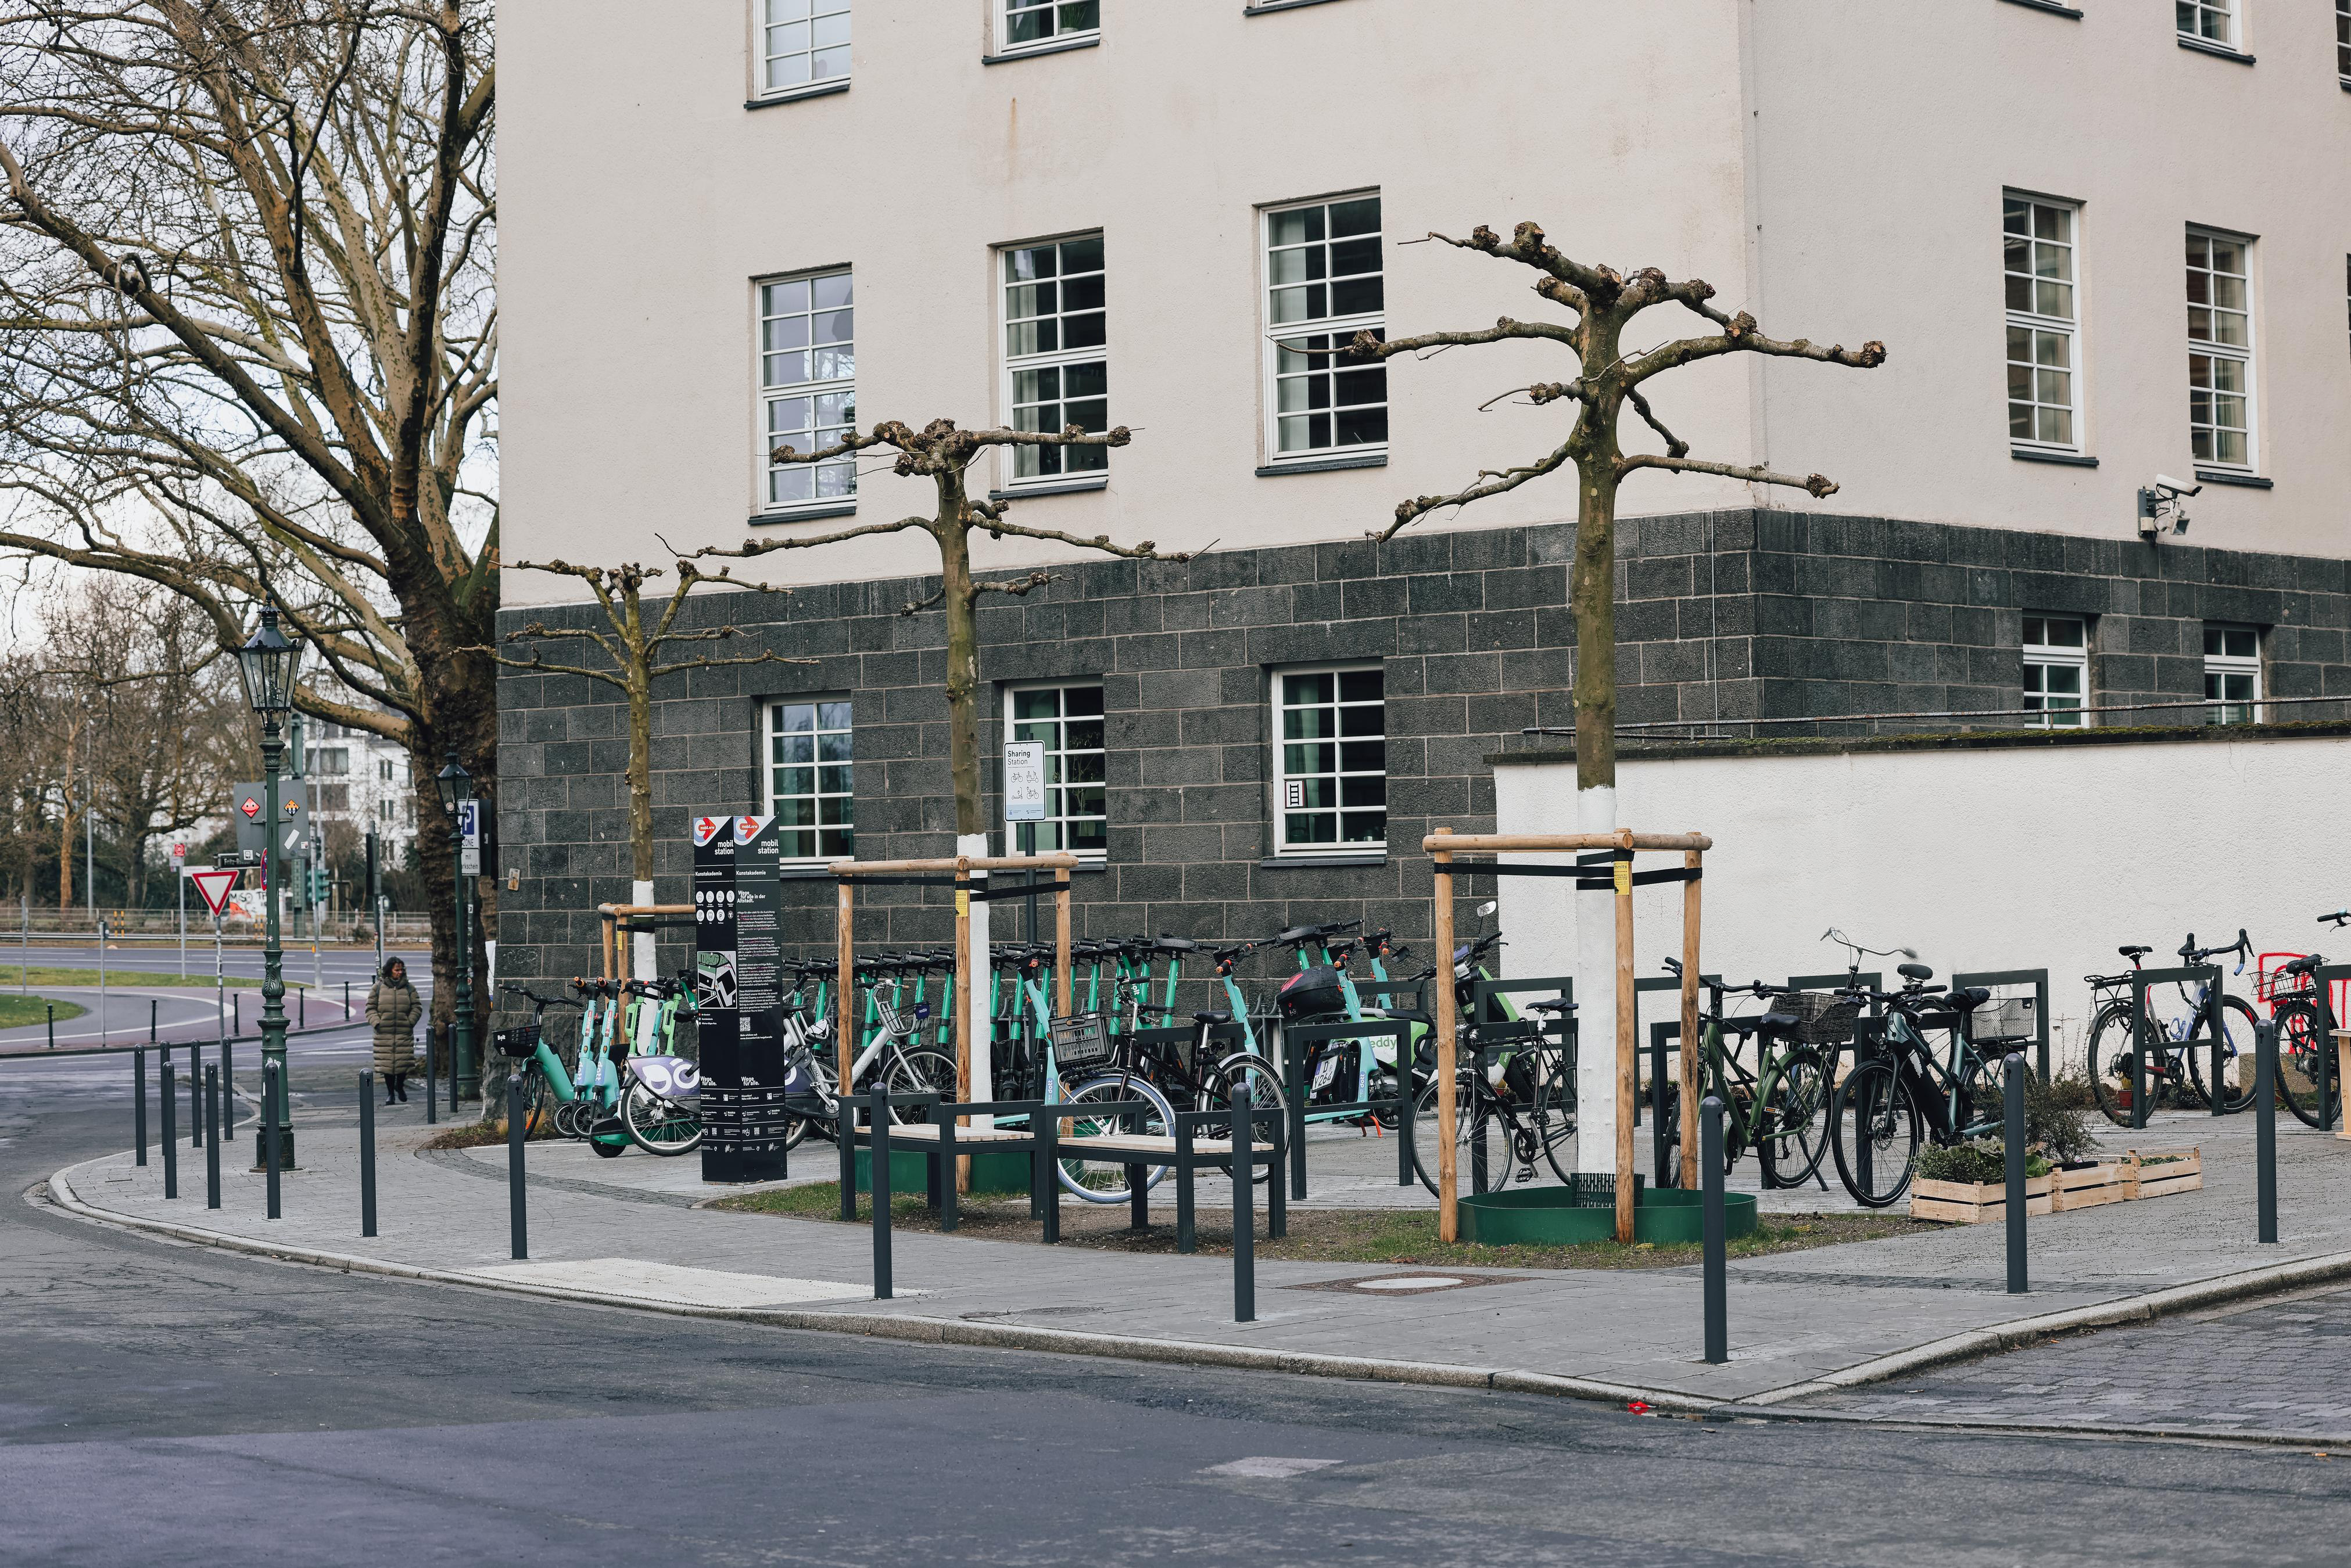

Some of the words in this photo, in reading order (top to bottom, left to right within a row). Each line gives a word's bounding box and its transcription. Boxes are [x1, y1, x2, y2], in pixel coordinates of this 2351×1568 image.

[464, 809, 472, 831] P
[1371, 1036, 1397, 1050] eddy
[1323, 1061, 1328, 1073] D
[1314, 1071, 1332, 1088] Y264
